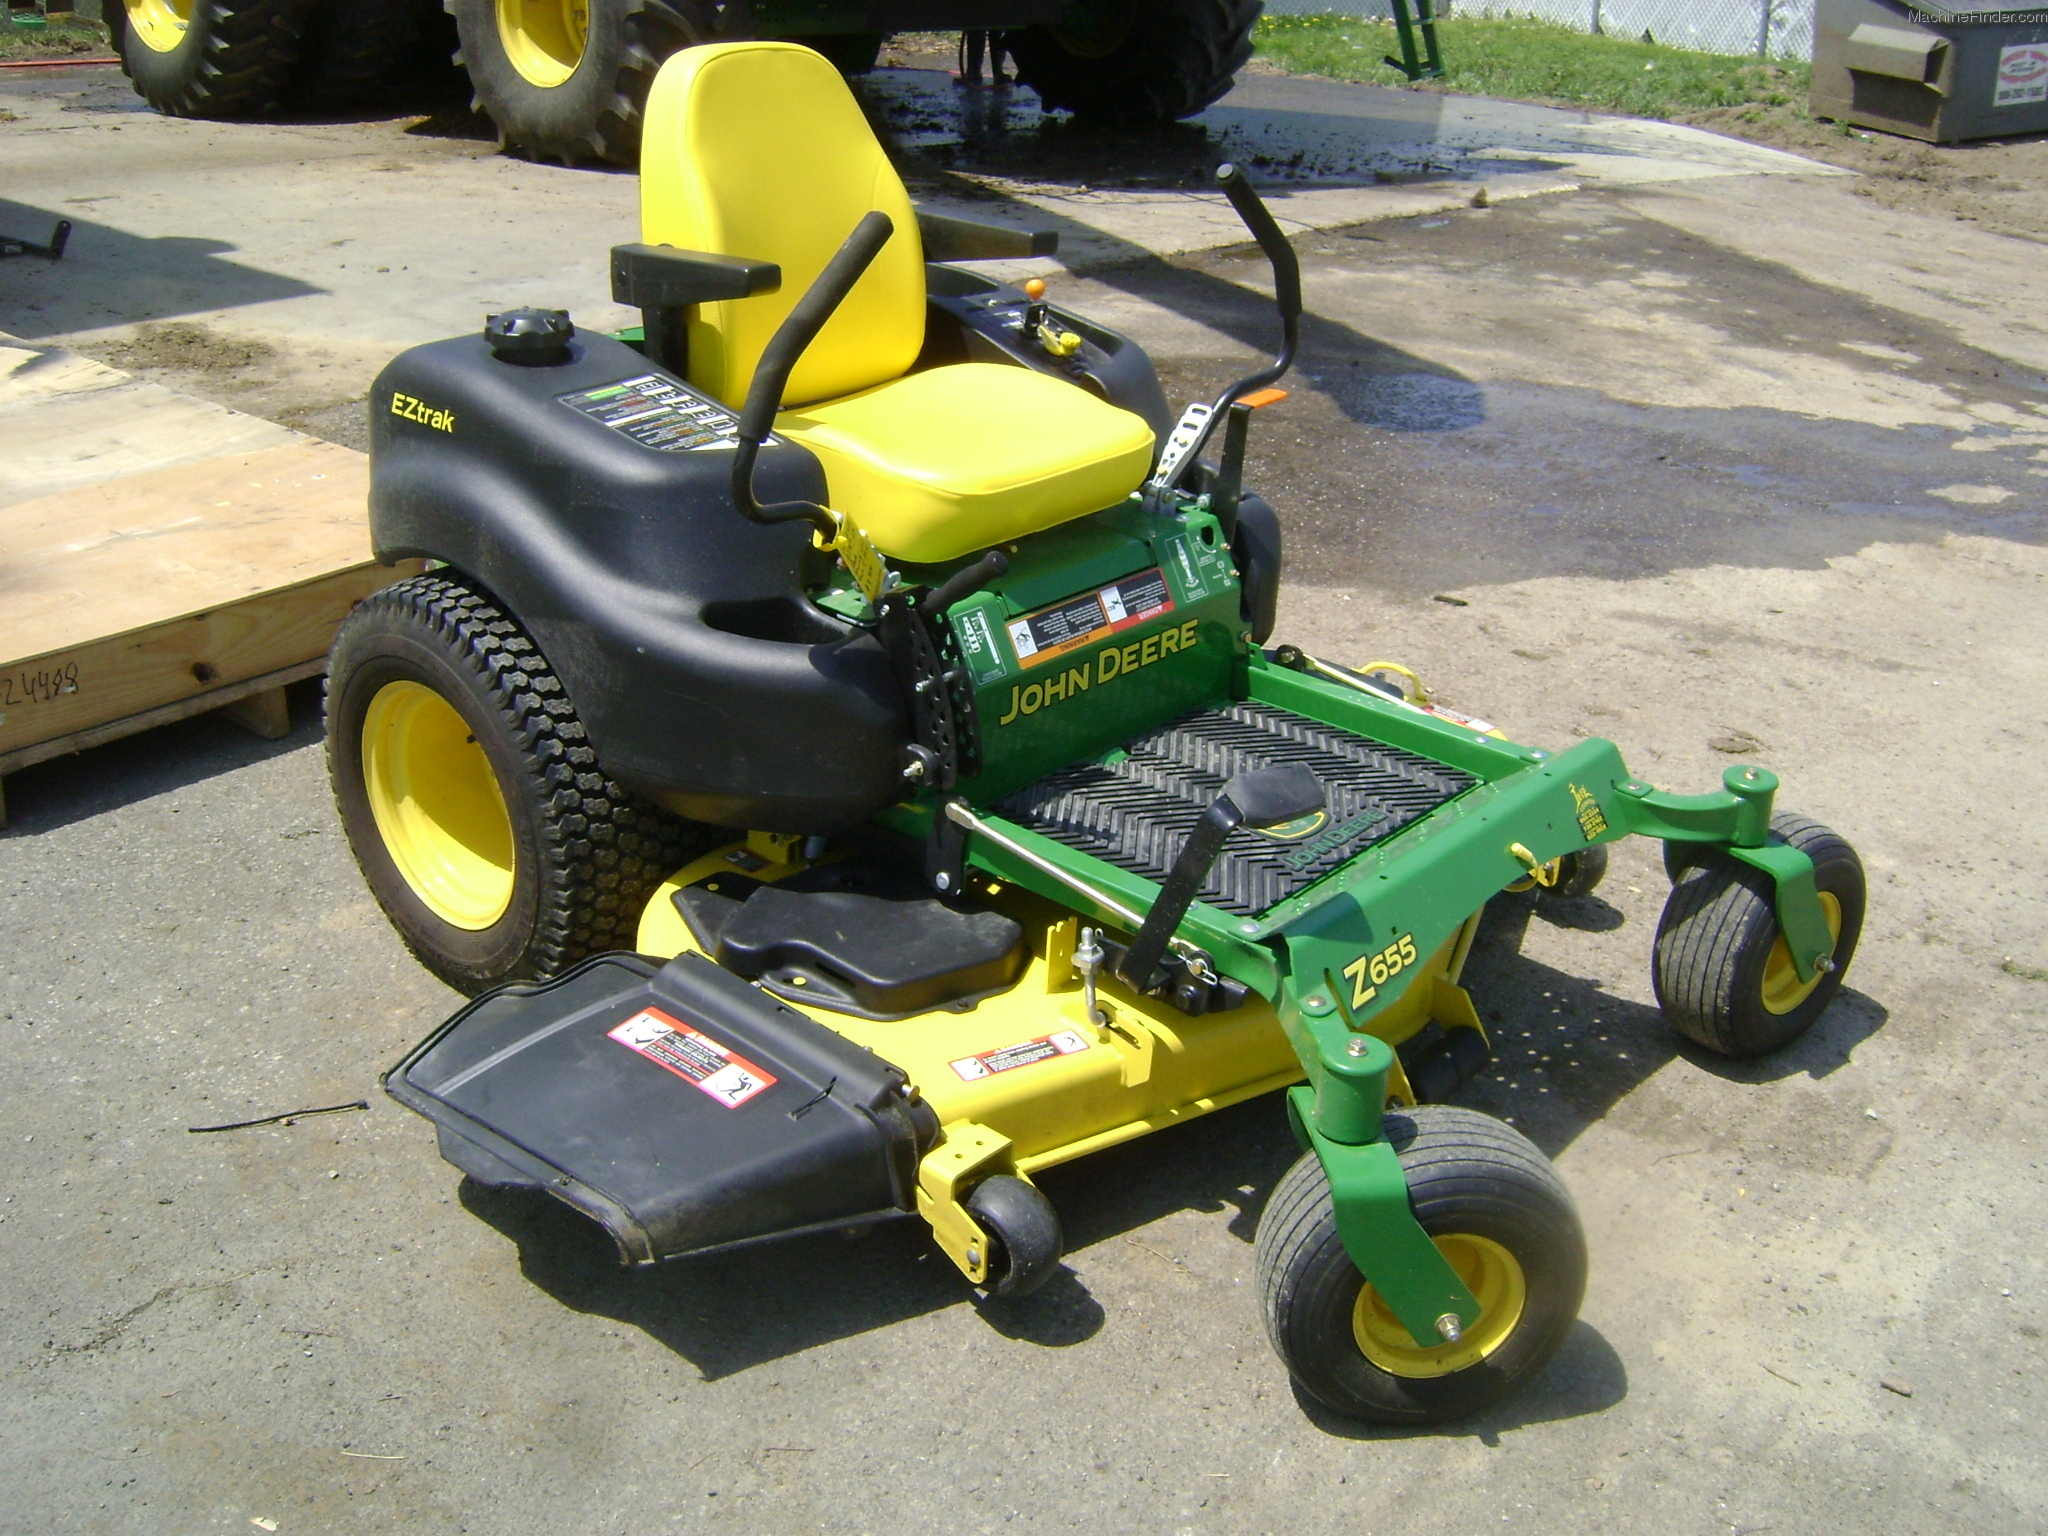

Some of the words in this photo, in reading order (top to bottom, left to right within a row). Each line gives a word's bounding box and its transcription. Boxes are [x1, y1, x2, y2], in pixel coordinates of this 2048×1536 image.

[391, 392, 455, 433] EZtrak
[1001, 662, 1090, 726] JOHN
[1097, 619, 1198, 685] DEERE
[1283, 836, 1335, 871] JOHN
[1326, 809, 1389, 847] DEERE
[1343, 933, 1417, 1010] Z655
